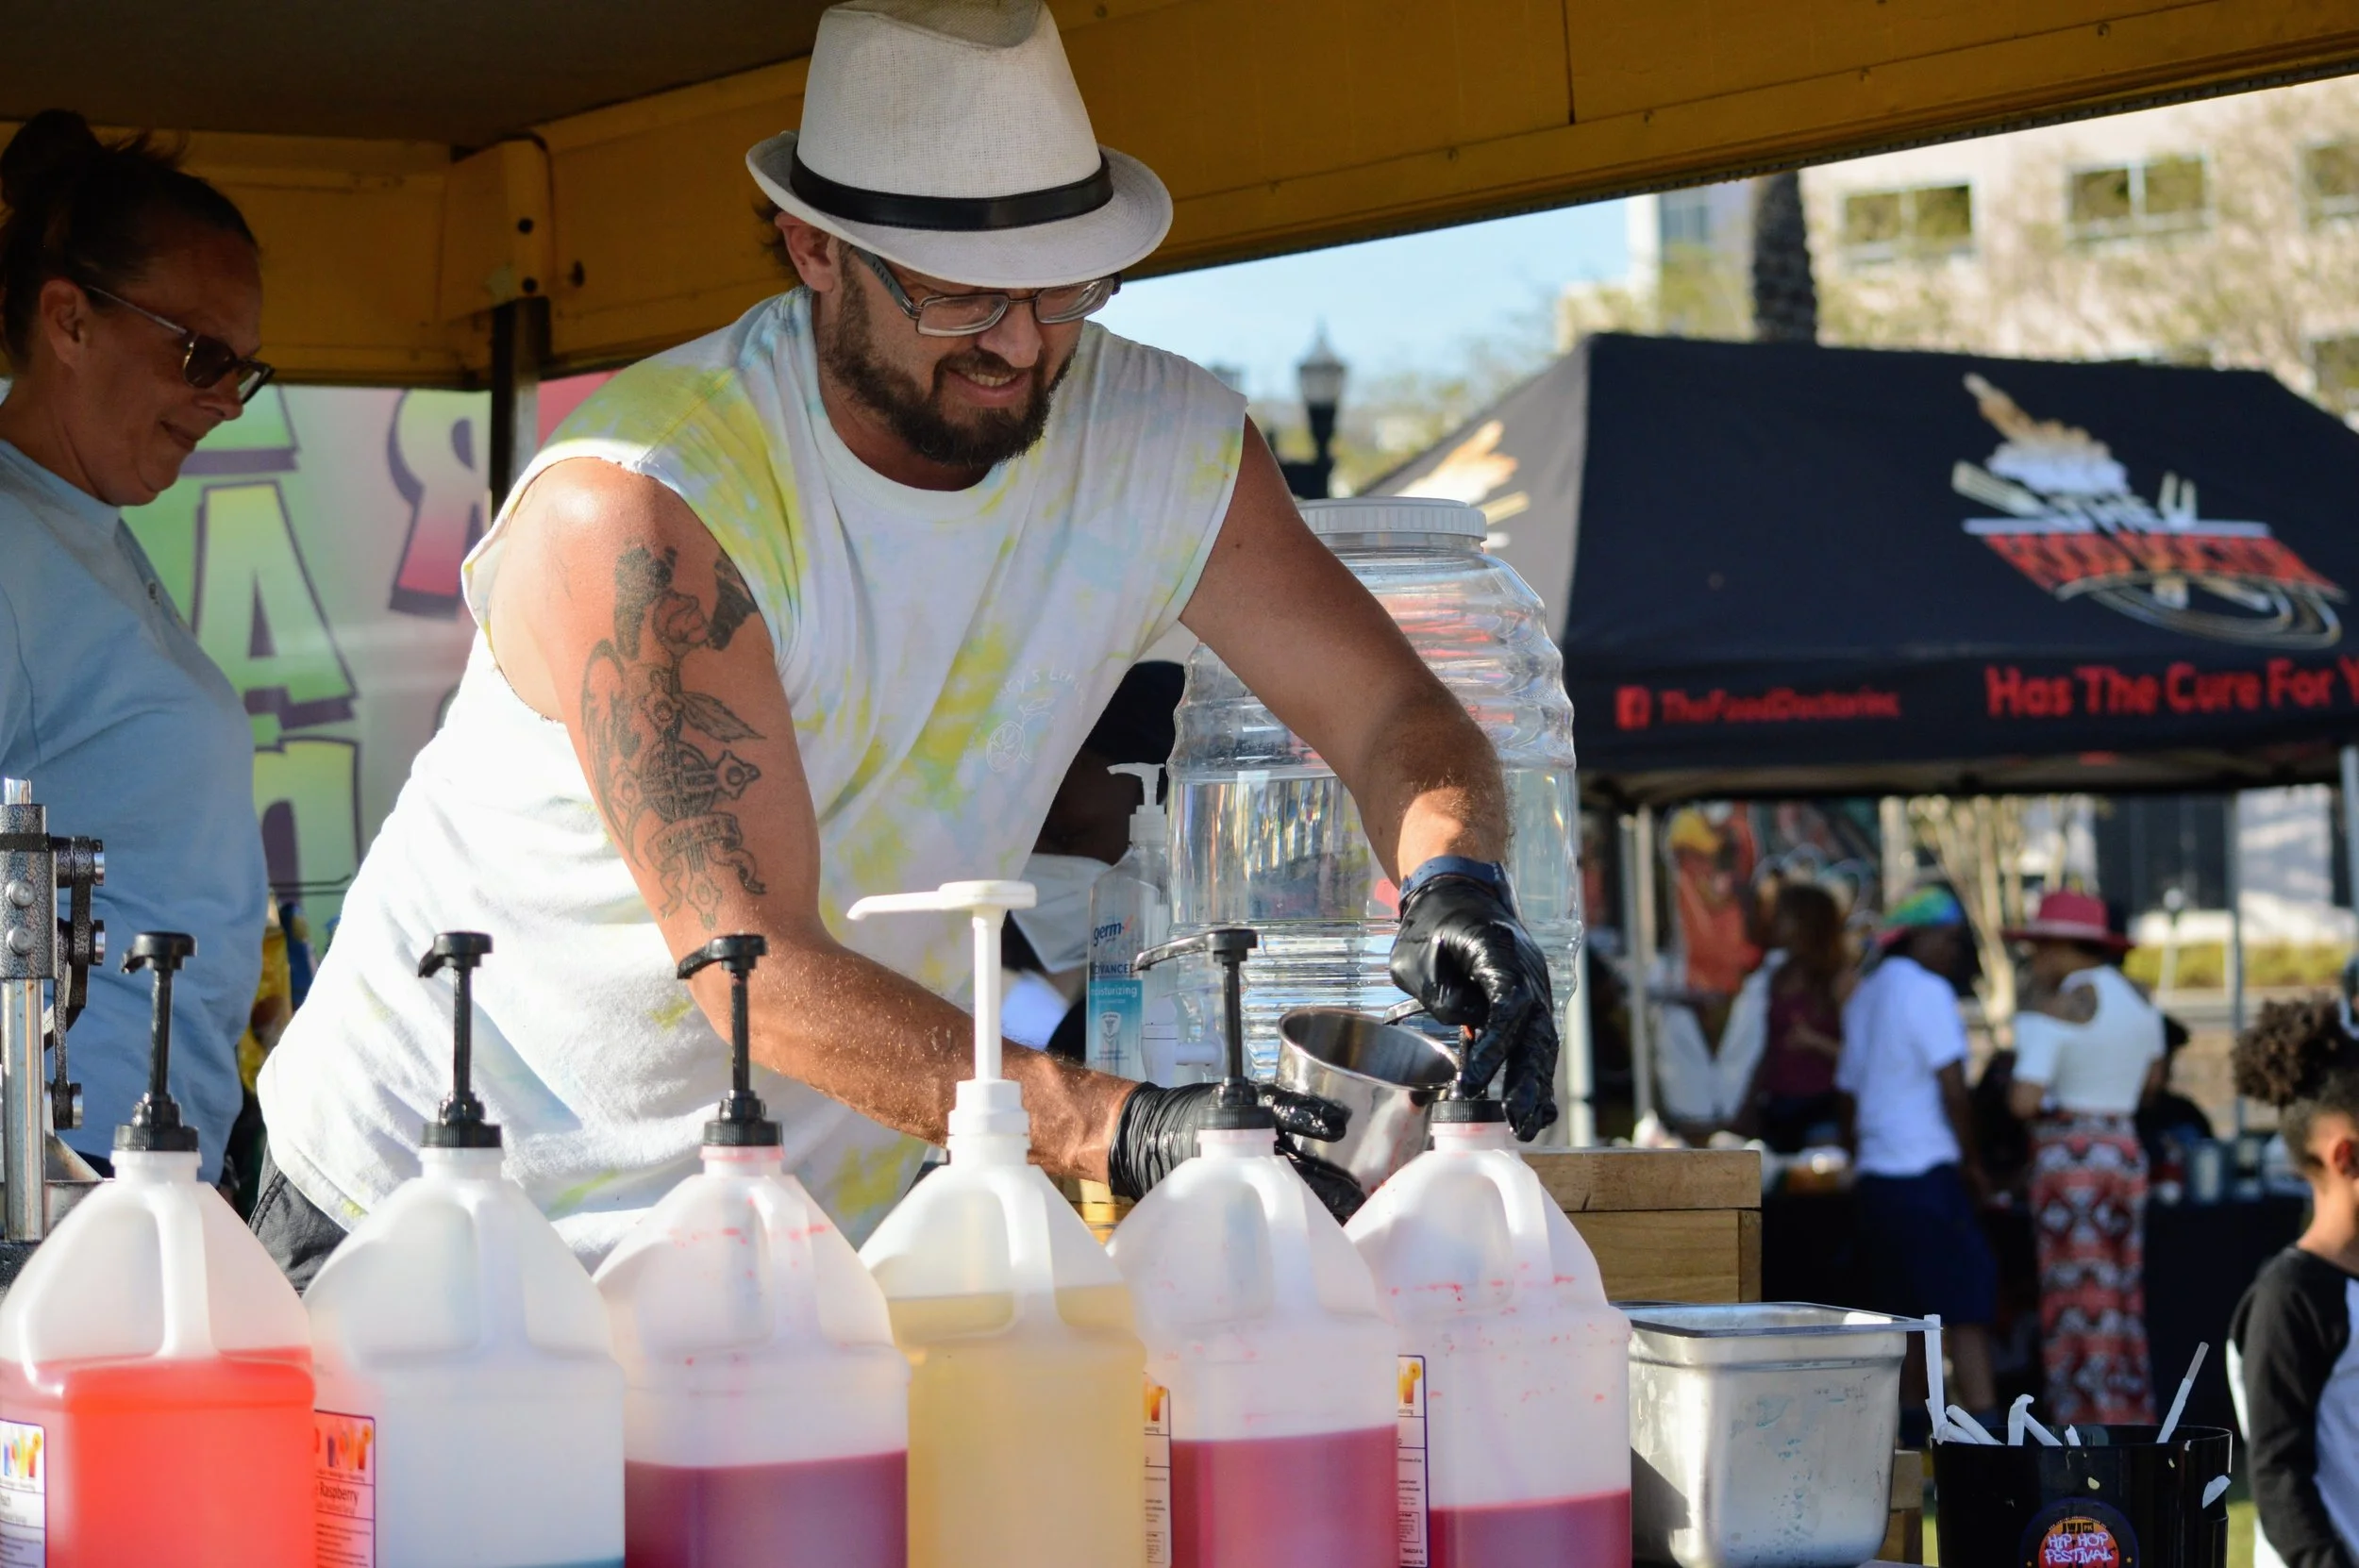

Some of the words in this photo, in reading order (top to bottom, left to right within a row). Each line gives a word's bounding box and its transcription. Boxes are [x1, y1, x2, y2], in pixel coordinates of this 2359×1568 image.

[1984, 664, 2074, 717] Has
[2075, 664, 2159, 716] The
[2166, 661, 2262, 712] Cure
[2267, 657, 2334, 709] For
[1090, 962, 1135, 975] DVANCE
[320, 1480, 360, 1507] Raspberry
[2047, 1532, 2073, 1550] HIP
[2076, 1531, 2109, 1548] HOP
[2044, 1545, 2114, 1566] FESTIVAL
